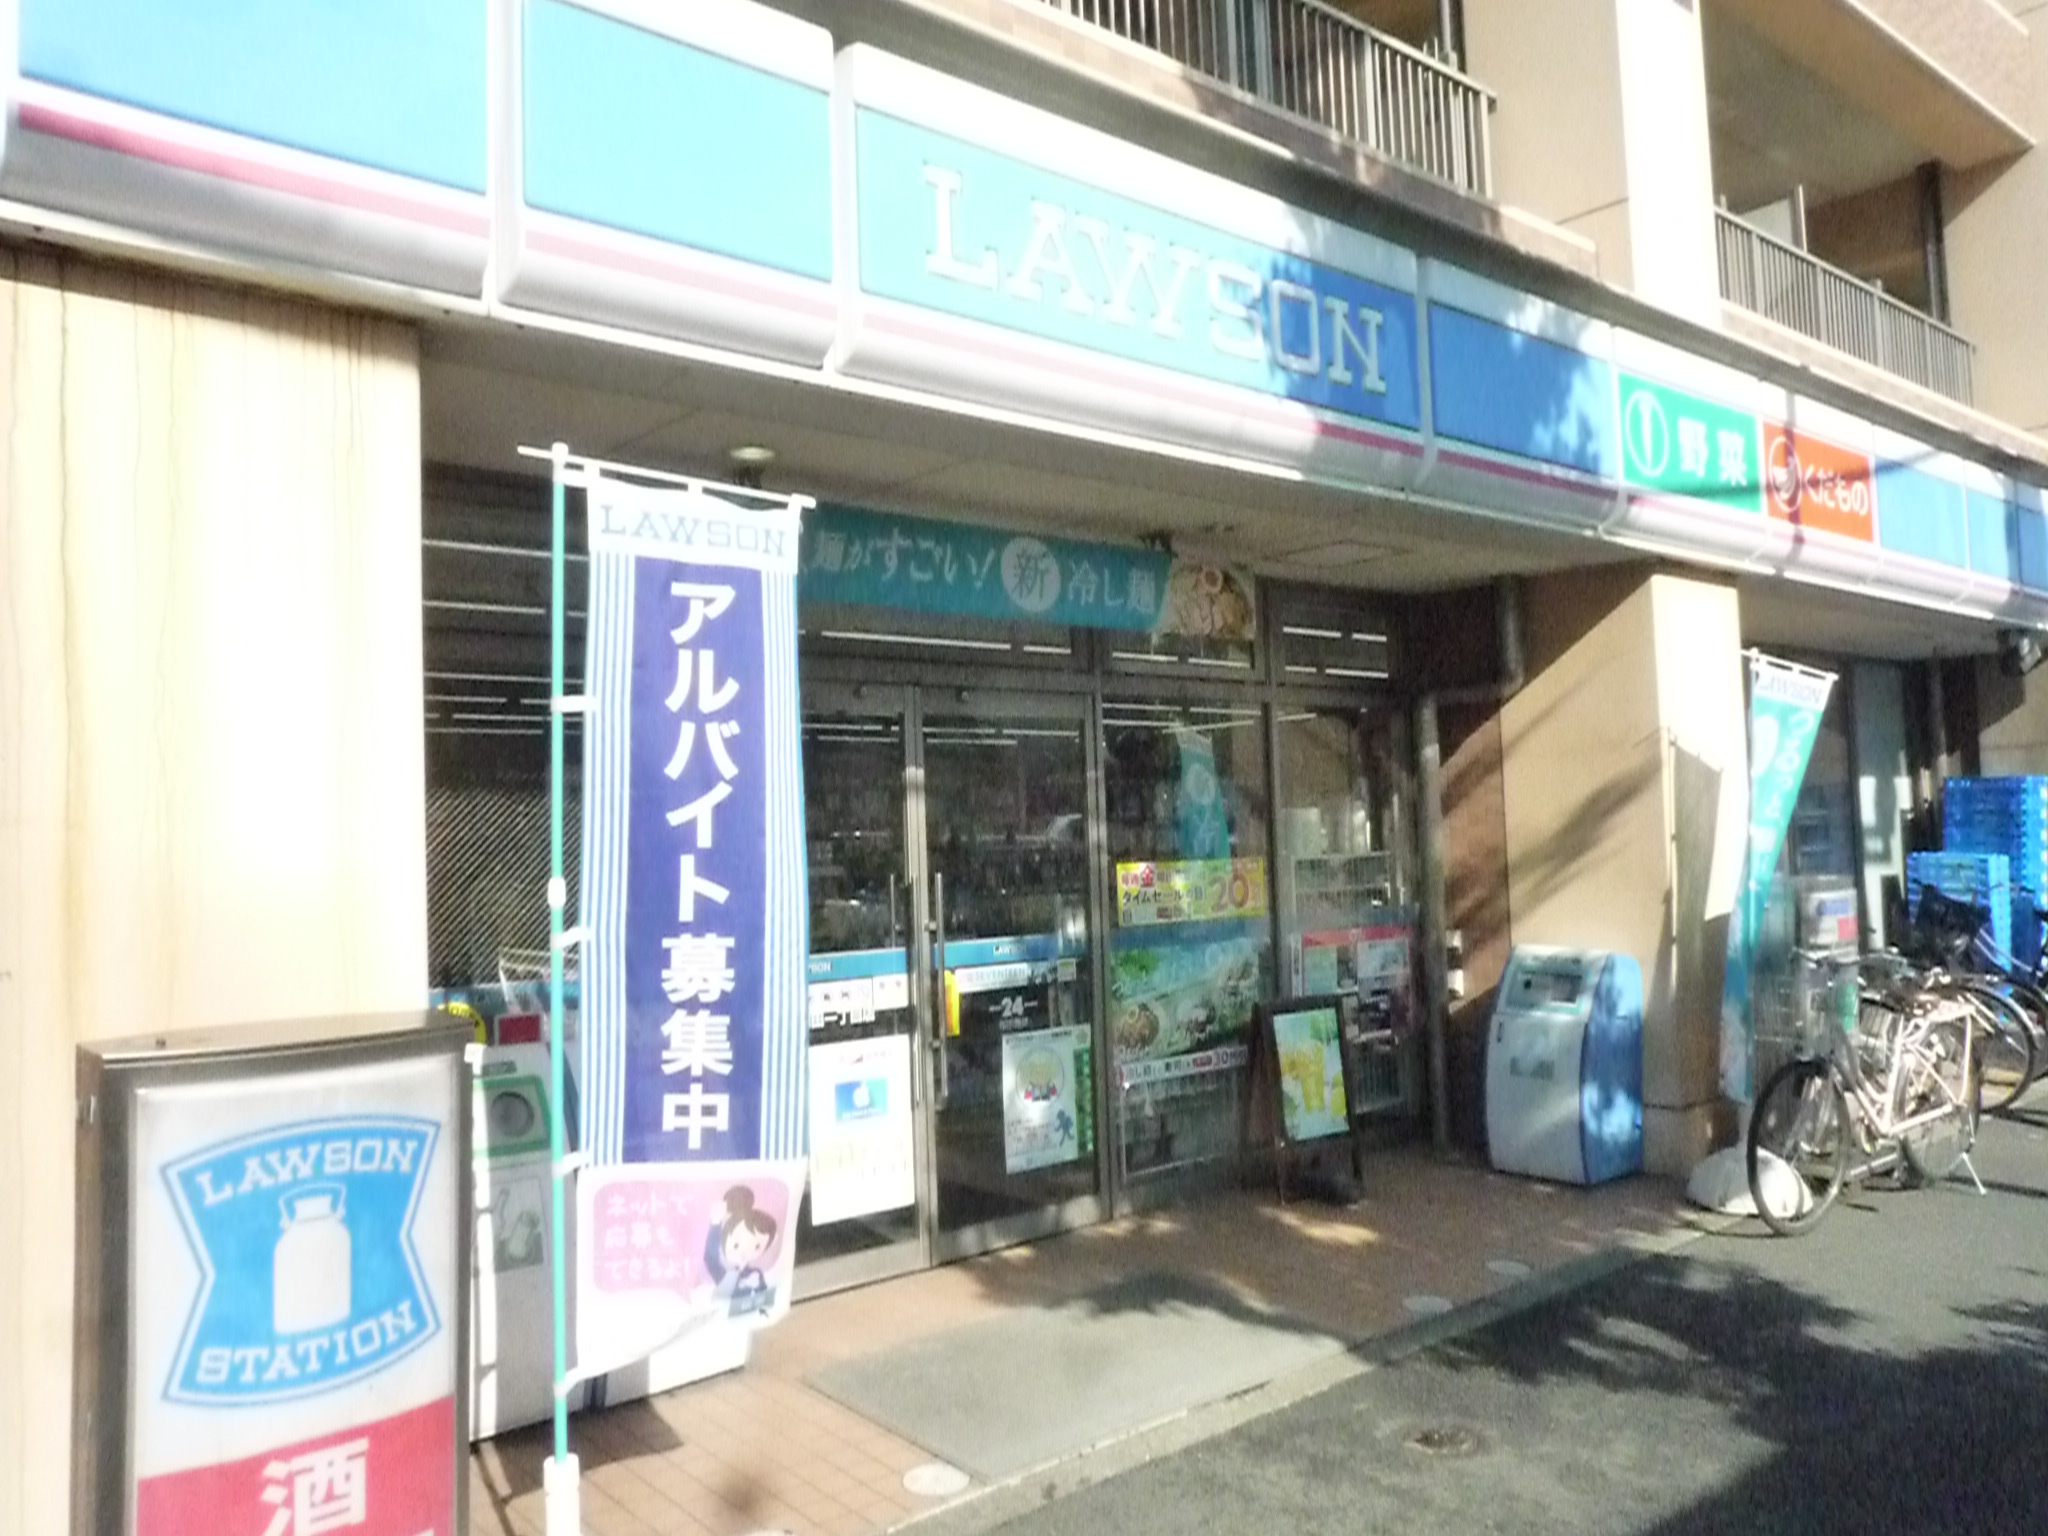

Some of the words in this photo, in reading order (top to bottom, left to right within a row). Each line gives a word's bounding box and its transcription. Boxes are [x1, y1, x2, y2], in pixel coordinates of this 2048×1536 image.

[921, 159, 1387, 395] LAWSON
[1676, 416, 1748, 487] 野菜
[1803, 464, 1870, 516] くだもの
[600, 504, 787, 557] LAWSON
[1013, 549, 1049, 601] 新
[660, 581, 741, 1150] アルバイト募集中
[195, 1138, 418, 1207] LAWSON
[606, 1193, 694, 1217] ネットで
[605, 1259, 691, 1280] できるよ!
[195, 1300, 418, 1385] STATION
[259, 1437, 370, 1536] 酒
